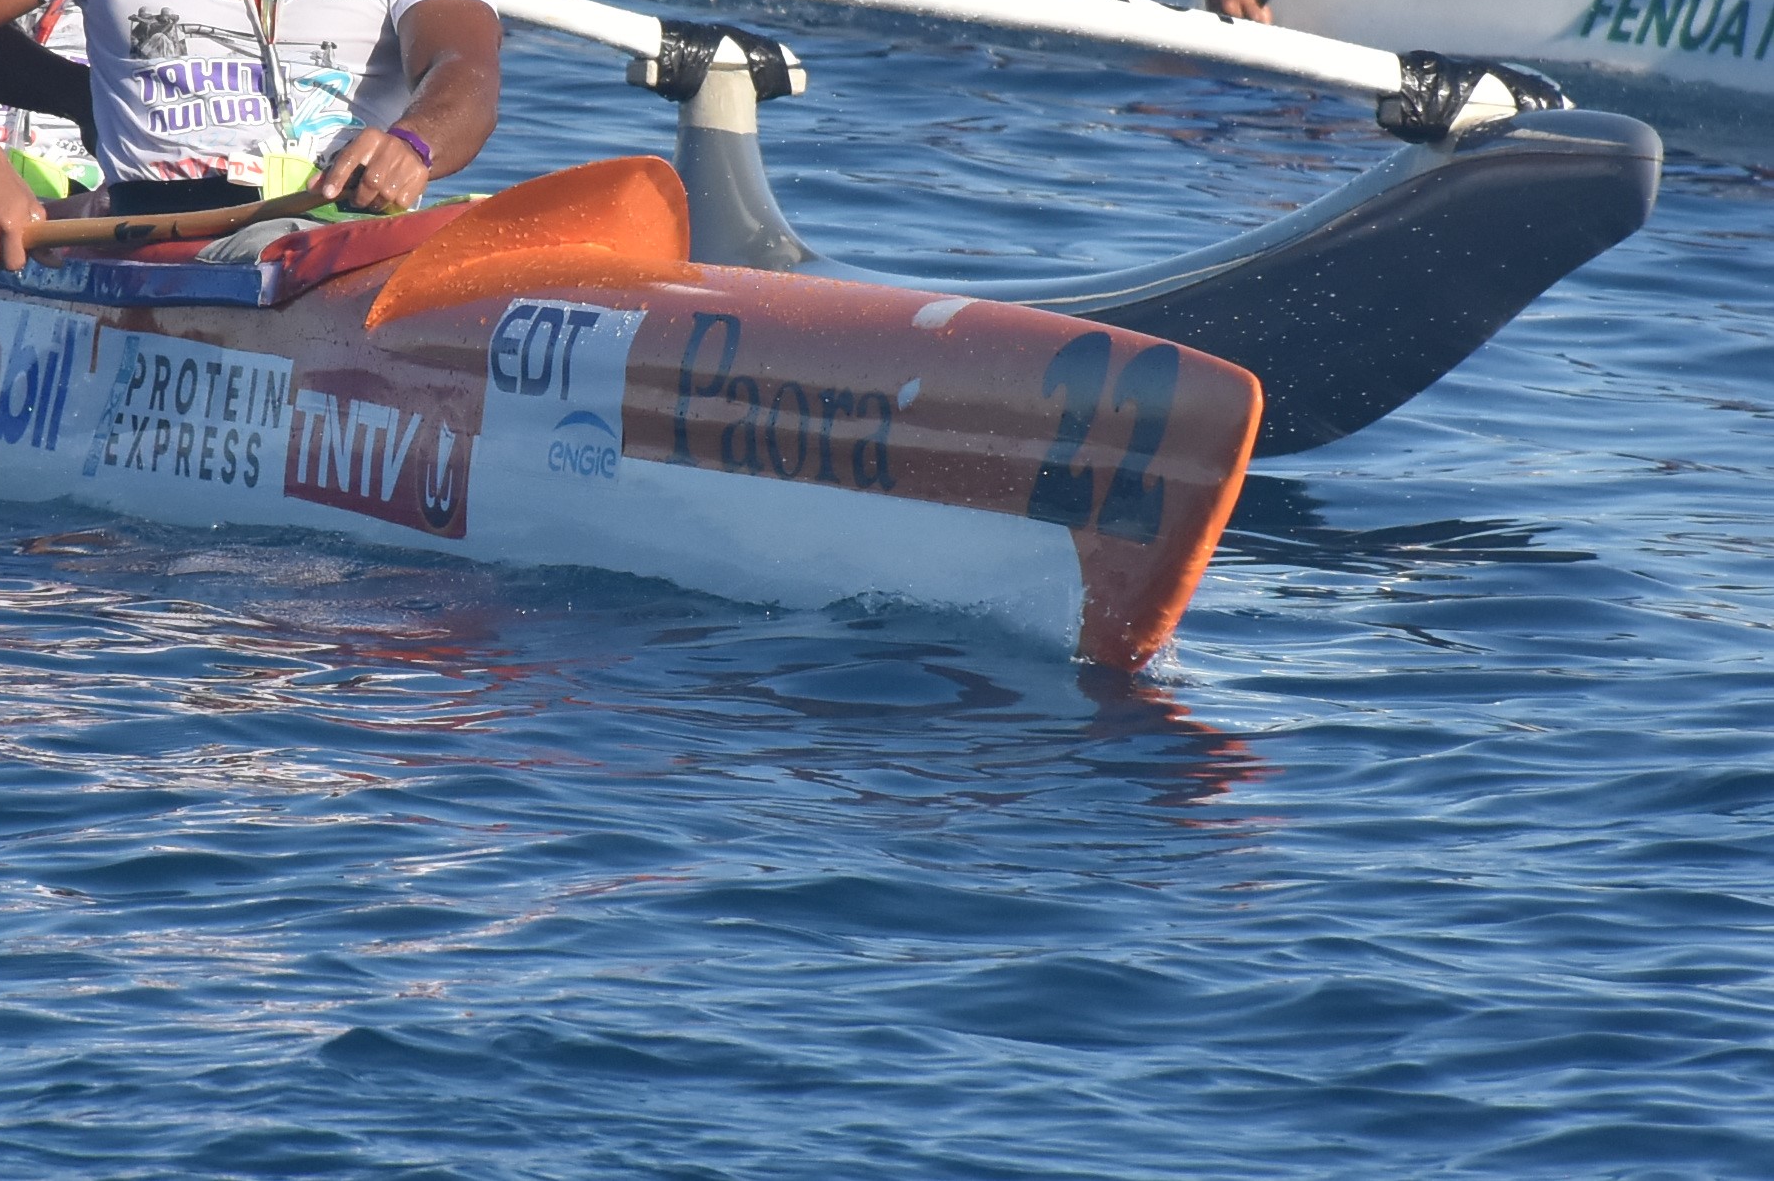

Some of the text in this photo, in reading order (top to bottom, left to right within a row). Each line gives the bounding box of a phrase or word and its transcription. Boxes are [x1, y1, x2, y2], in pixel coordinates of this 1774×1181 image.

[149, 102, 204, 133] NUI
[125, 351, 287, 429] PROTEIN
[490, 303, 601, 401] EDT
[103, 413, 262, 489] EXPRESS
[295, 388, 424, 502] TNTV
[1027, 330, 1181, 546] 22
